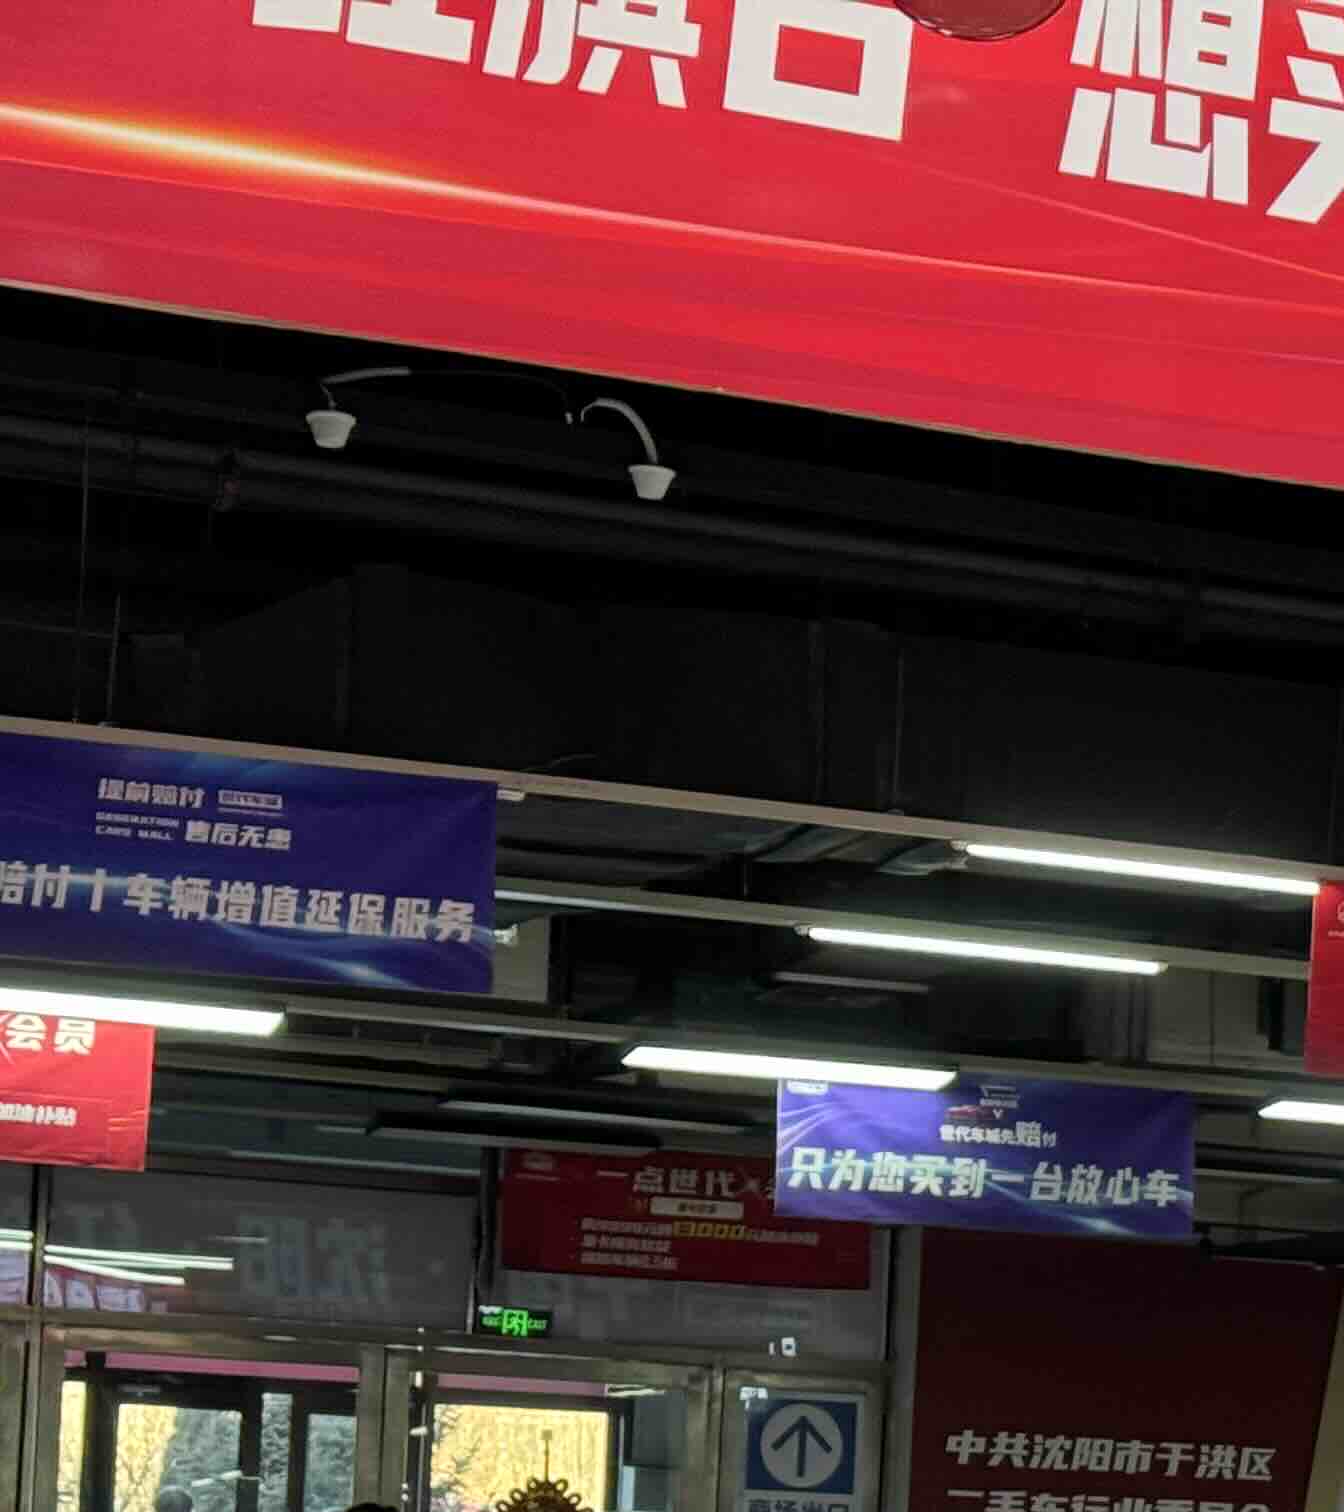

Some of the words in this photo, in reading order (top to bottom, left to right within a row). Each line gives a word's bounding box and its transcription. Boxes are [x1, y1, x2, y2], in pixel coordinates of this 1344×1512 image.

[787, 1147, 1179, 1207] 只为您买到一台放心车
[945, 1429, 1277, 1482] 中共沈阳市于洪区
